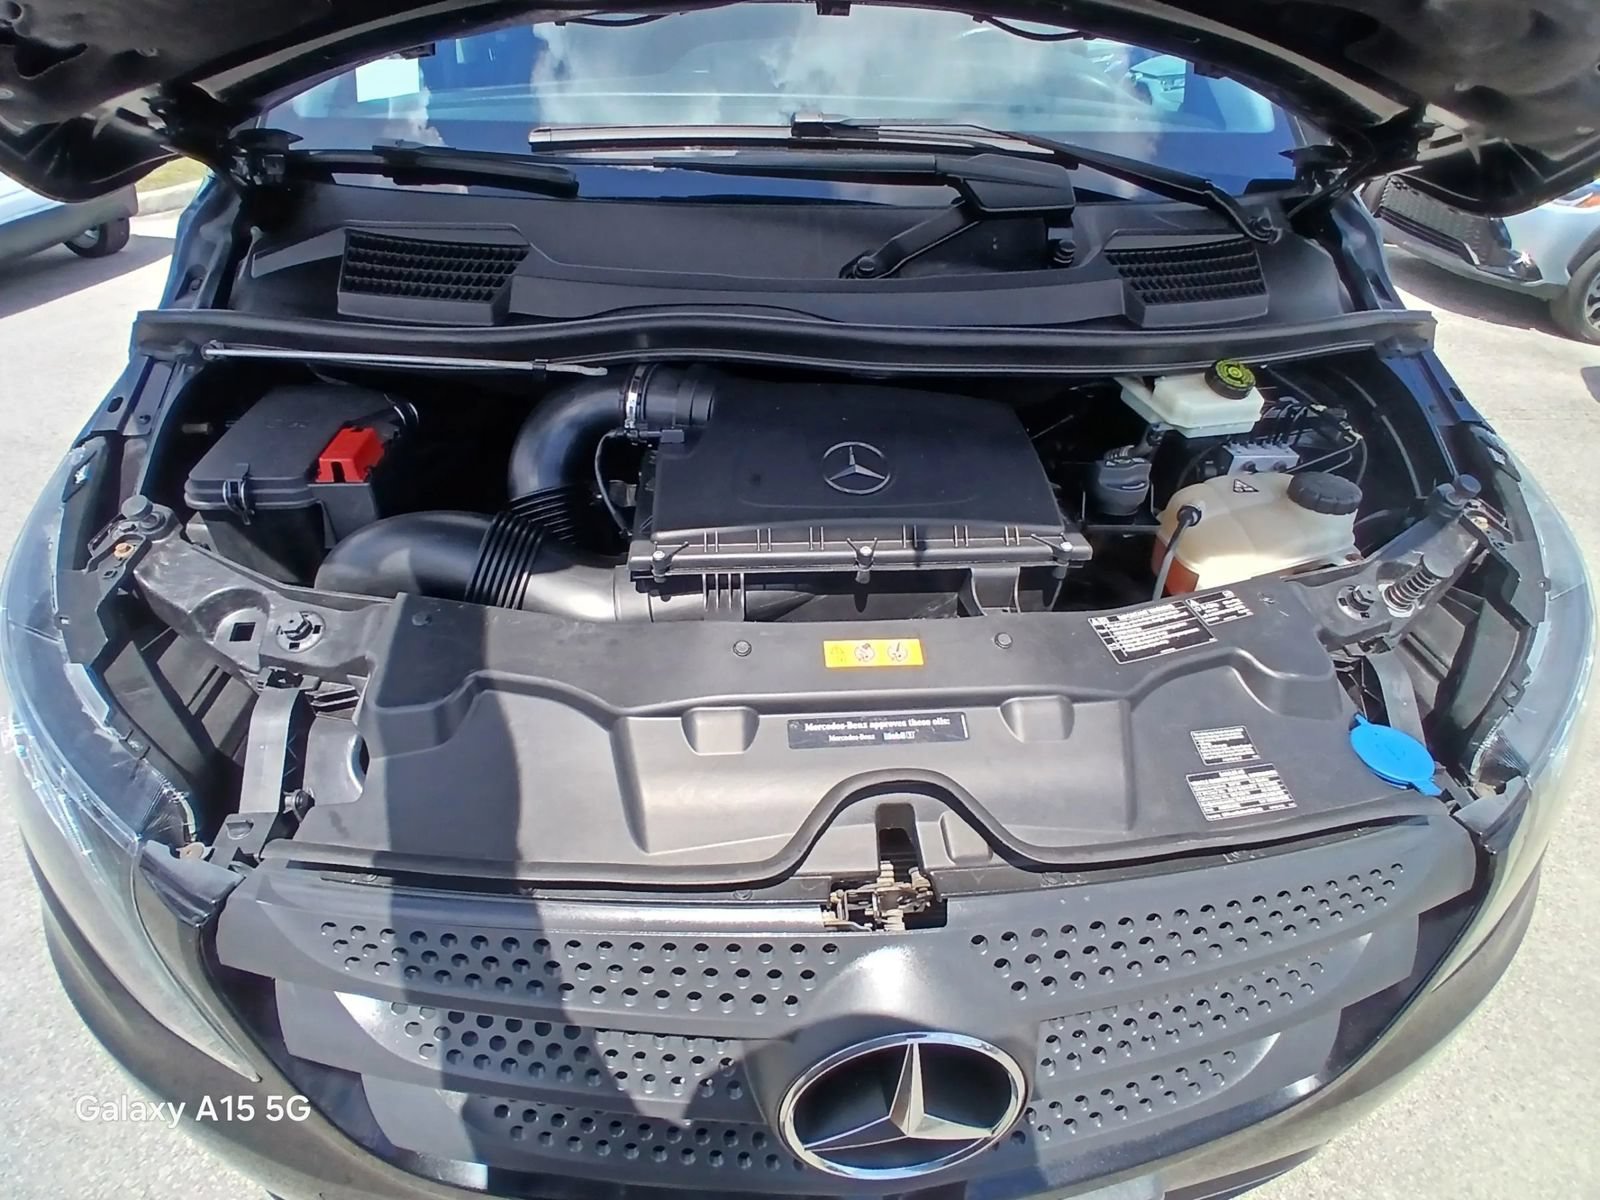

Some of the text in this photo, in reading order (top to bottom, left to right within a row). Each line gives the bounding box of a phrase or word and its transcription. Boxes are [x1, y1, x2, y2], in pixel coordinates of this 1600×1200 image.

[804, 721, 868, 732] Mercedes-Benz
[869, 720, 907, 730] approves
[908, 718, 931, 727] these
[828, 733, 875, 742] Mercedes-Benz
